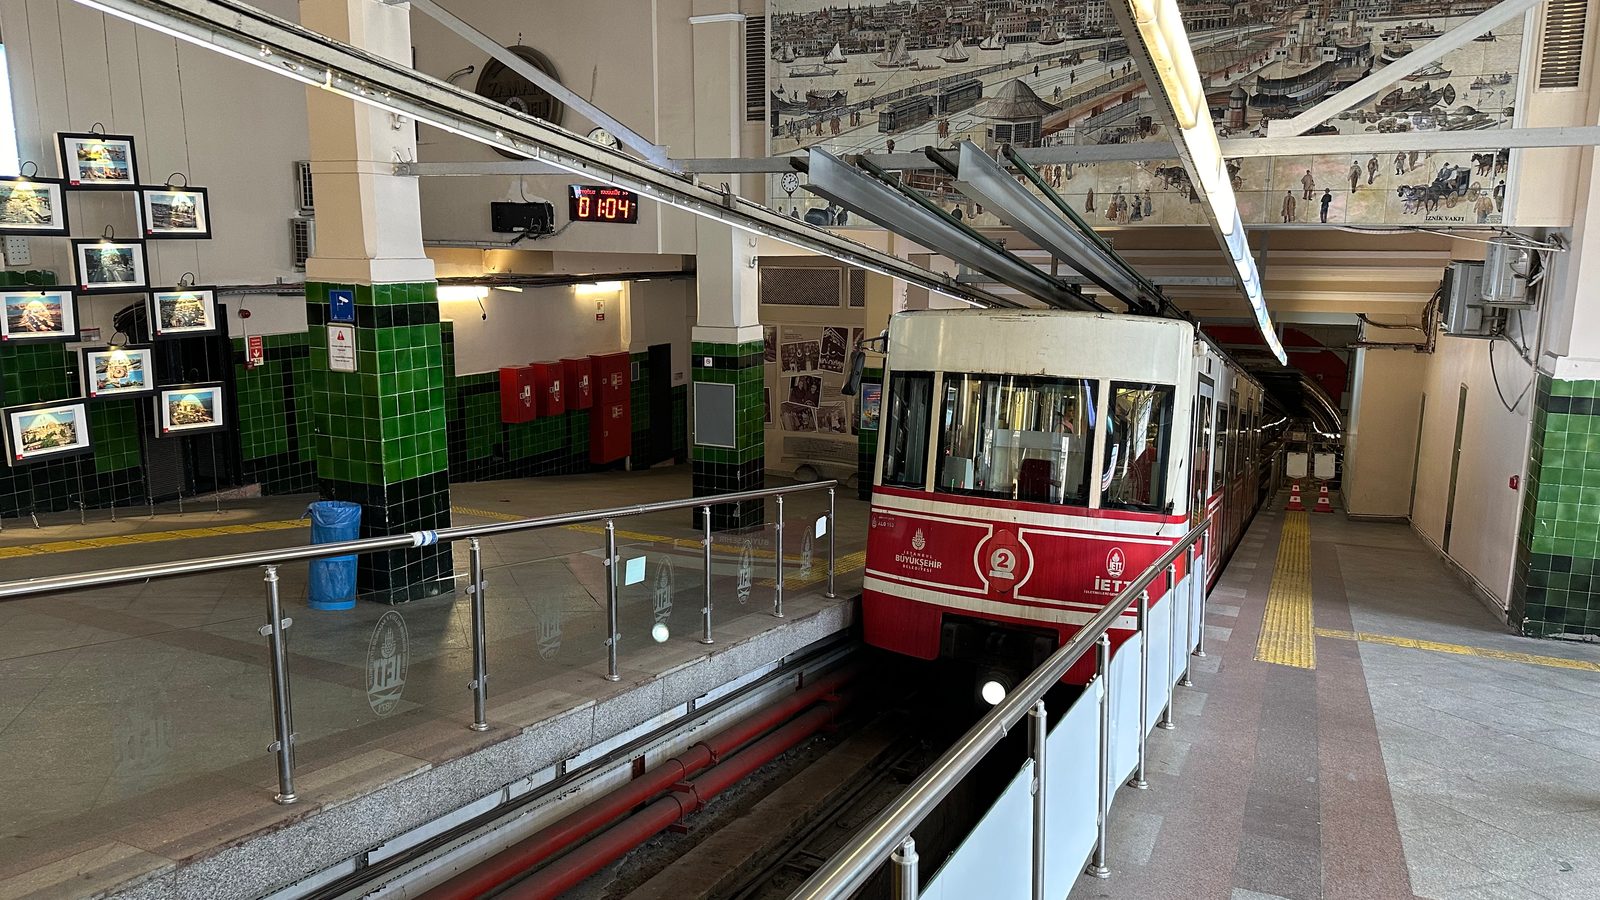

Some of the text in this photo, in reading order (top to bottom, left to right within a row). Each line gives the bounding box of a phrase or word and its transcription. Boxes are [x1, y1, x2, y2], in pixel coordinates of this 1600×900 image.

[578, 196, 629, 219] 01:04
[895, 553, 942, 569] BÜYÜKŞEHİR
[997, 552, 1009, 569] 2
